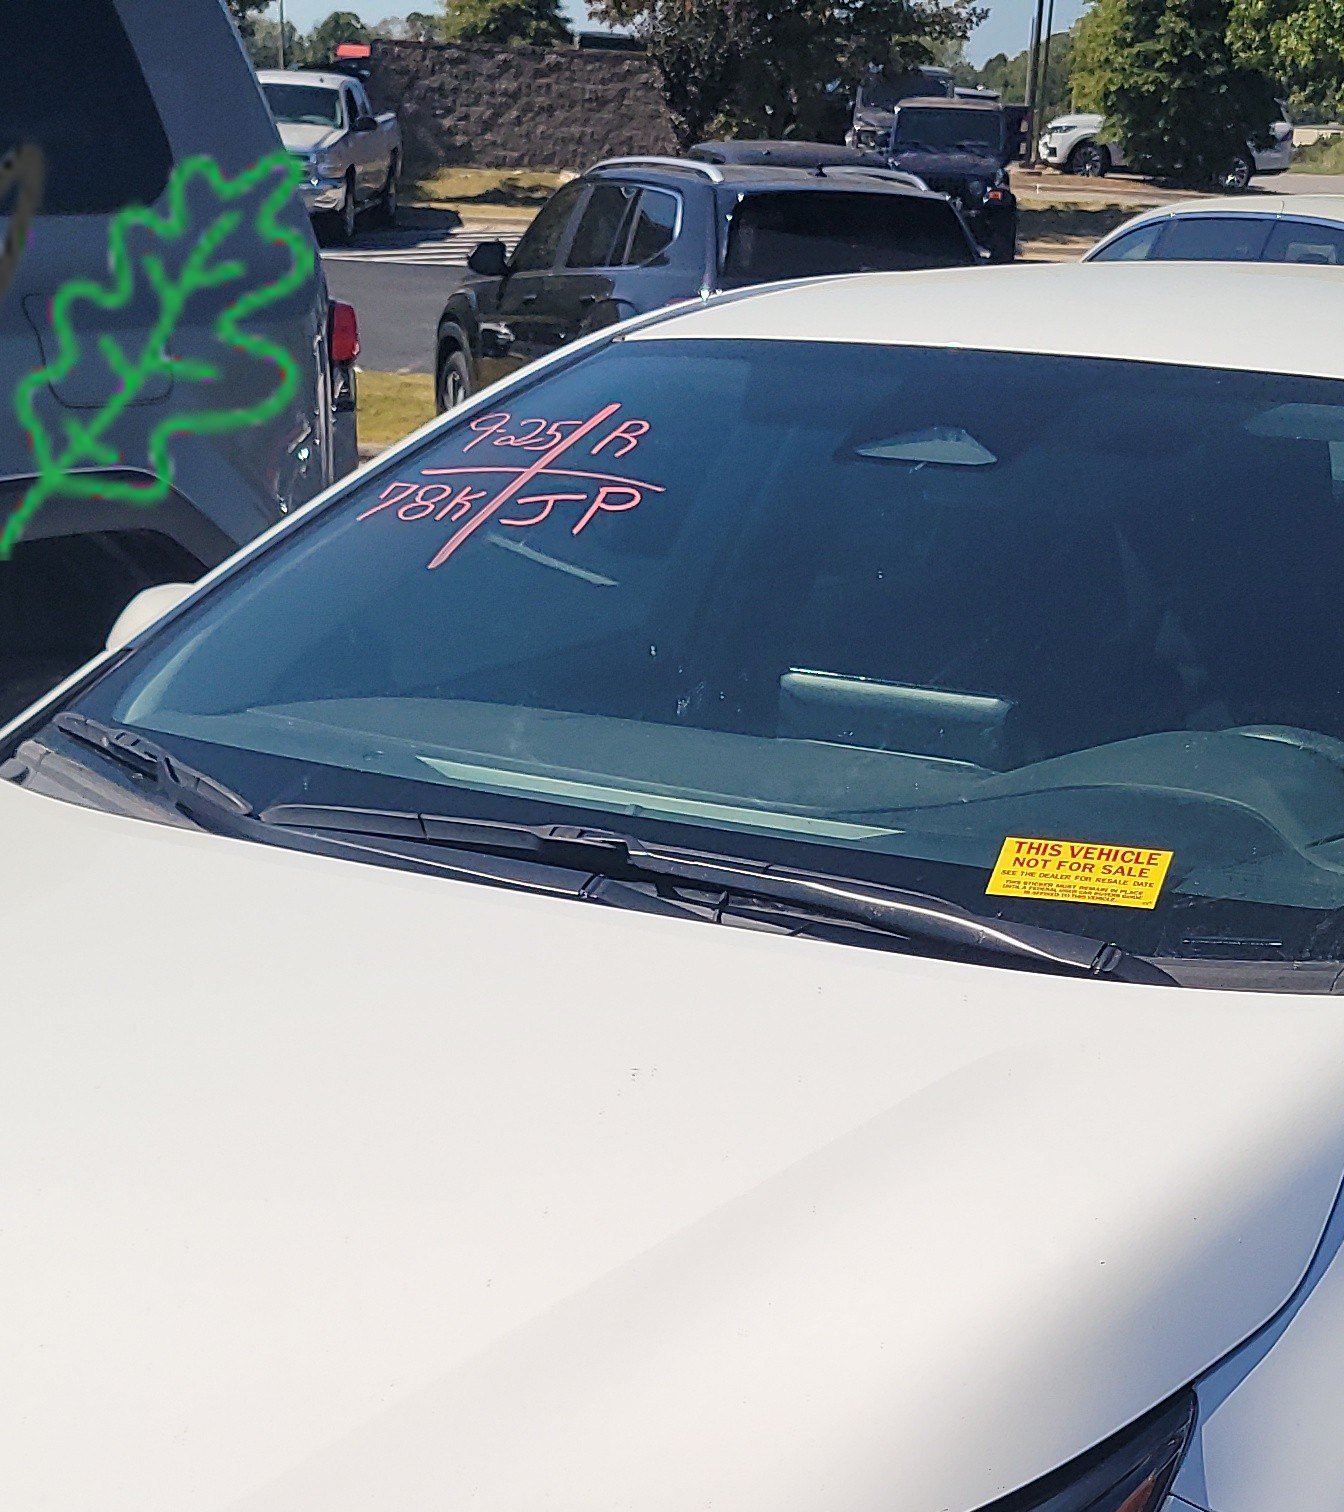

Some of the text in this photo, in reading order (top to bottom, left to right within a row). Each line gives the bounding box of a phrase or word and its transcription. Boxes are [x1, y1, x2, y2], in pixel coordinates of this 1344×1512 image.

[1015, 841, 1162, 865] THIS VEHICLE
[1012, 856, 1150, 878] NOT FOR SALE
